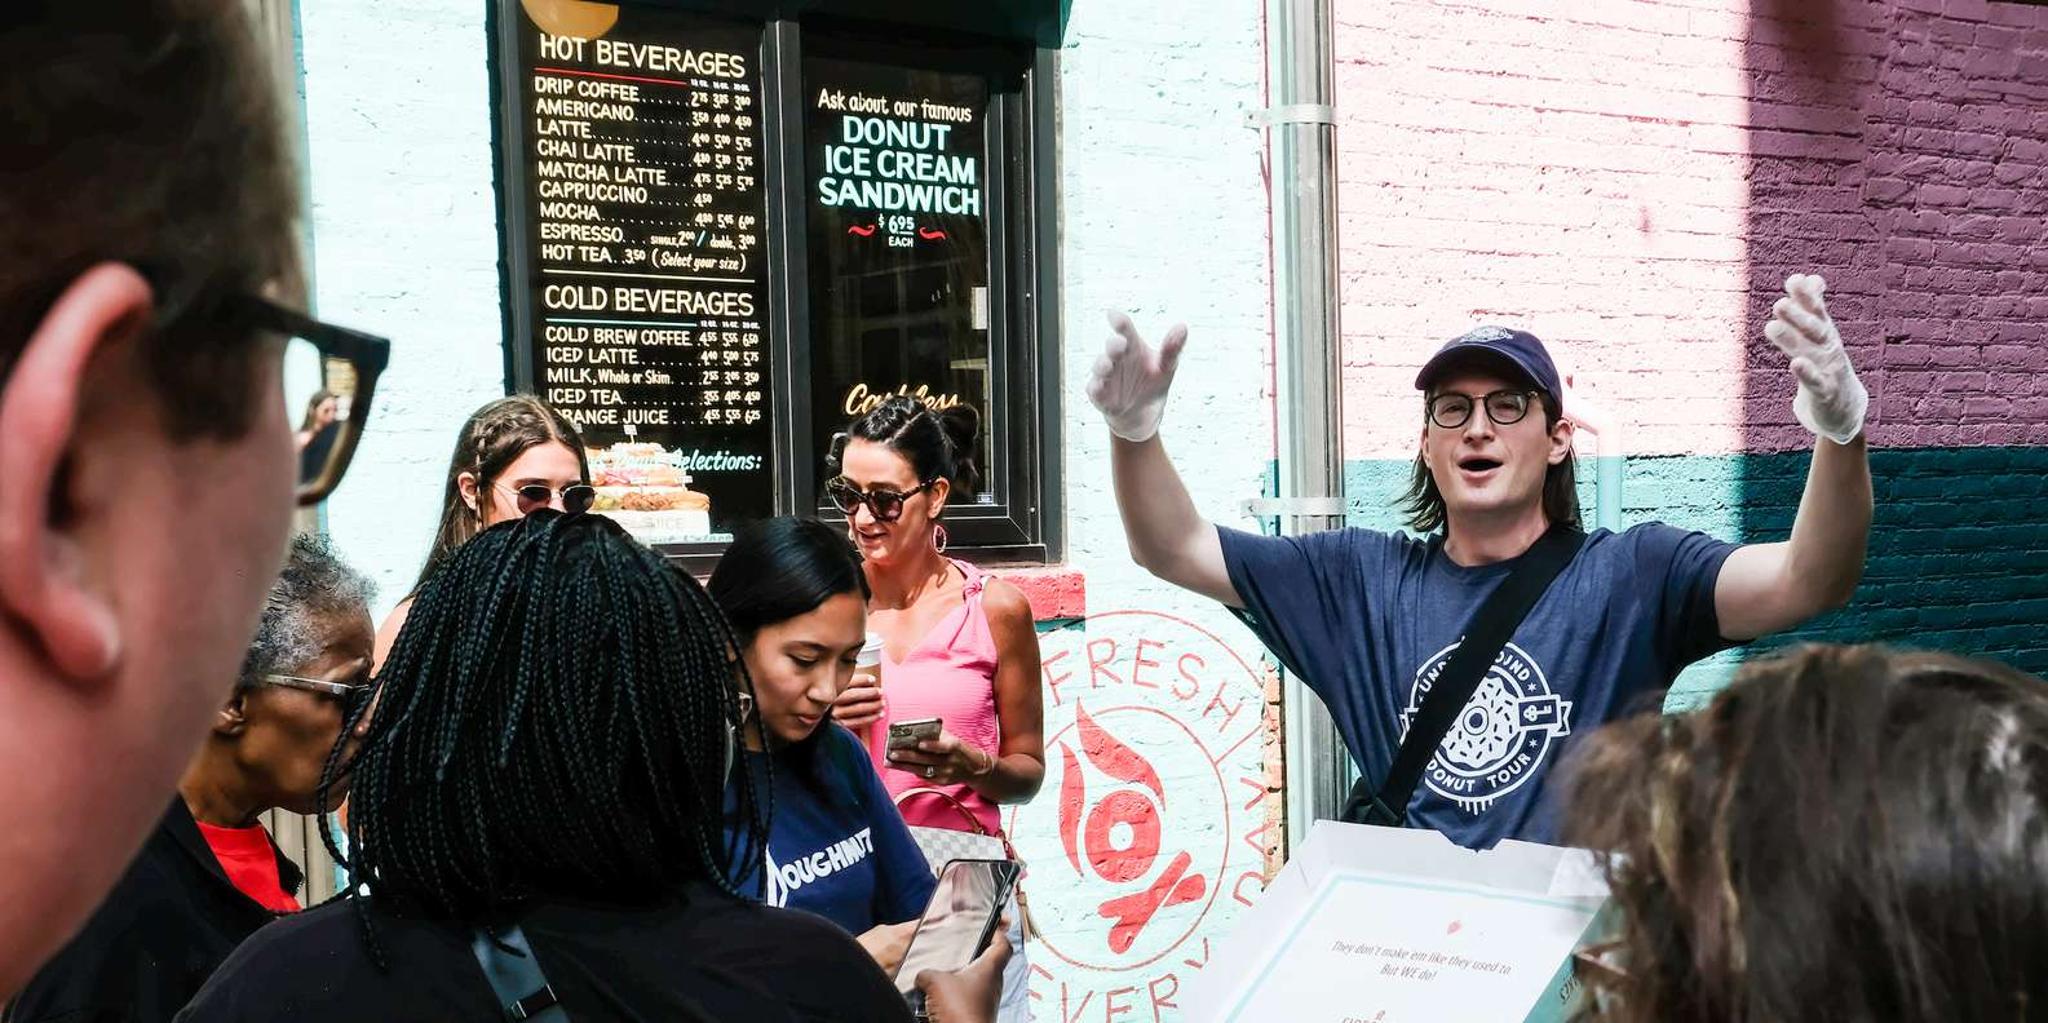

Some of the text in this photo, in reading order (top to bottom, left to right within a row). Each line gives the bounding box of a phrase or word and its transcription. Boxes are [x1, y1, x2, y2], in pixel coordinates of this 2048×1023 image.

[539, 33, 745, 78] HOT BEVERAGES
[535, 76, 573, 95] DRIP
[578, 81, 640, 102] COFFEE
[536, 98, 634, 121] AMERICANO
[818, 88, 973, 122] Ask about our famous
[537, 119, 592, 138] LATTE
[843, 115, 951, 150] DONUT
[538, 139, 577, 157] CHAI
[584, 143, 635, 163] LATTE
[538, 161, 610, 181] MATCHA
[615, 167, 667, 186] LATTE
[825, 145, 975, 185] ICE CREAM
[539, 180, 648, 204] CAPPUCCINO
[818, 176, 980, 216] SANDWICH
[540, 202, 600, 221] MOCHA
[541, 223, 624, 243] ESPRESSO
[888, 235, 914, 248] EACH
[542, 244, 574, 261] HOT
[579, 246, 612, 264] TEA
[693, 258, 717, 272] your
[545, 285, 754, 316] COLD BEVERAGES
[545, 326, 589, 343] COLD
[594, 328, 638, 345] BREW
[641, 330, 691, 347] COFFEE
[546, 347, 583, 363] ICED
[589, 348, 639, 365] LATTE
[547, 367, 598, 386] MILK,
[598, 369, 630, 385] Whole
[632, 372, 645, 385] or
[645, 370, 671, 385] Skim
[548, 388, 586, 404] ICED
[590, 389, 624, 405] TEA
[553, 408, 618, 425] RANGE
[623, 410, 669, 425] JUICE
[1042, 638, 1243, 733] FRESH
[1426, 752, 1531, 792] DONUT TOUR
[1332, 940, 1354, 957] They
[1381, 948, 1409, 960] make
[1428, 952, 1447, 965] like
[1448, 956, 1472, 970] they
[1472, 960, 1499, 973] used
[1499, 964, 1512, 975] to
[1380, 963, 1438, 981] But WE do!
